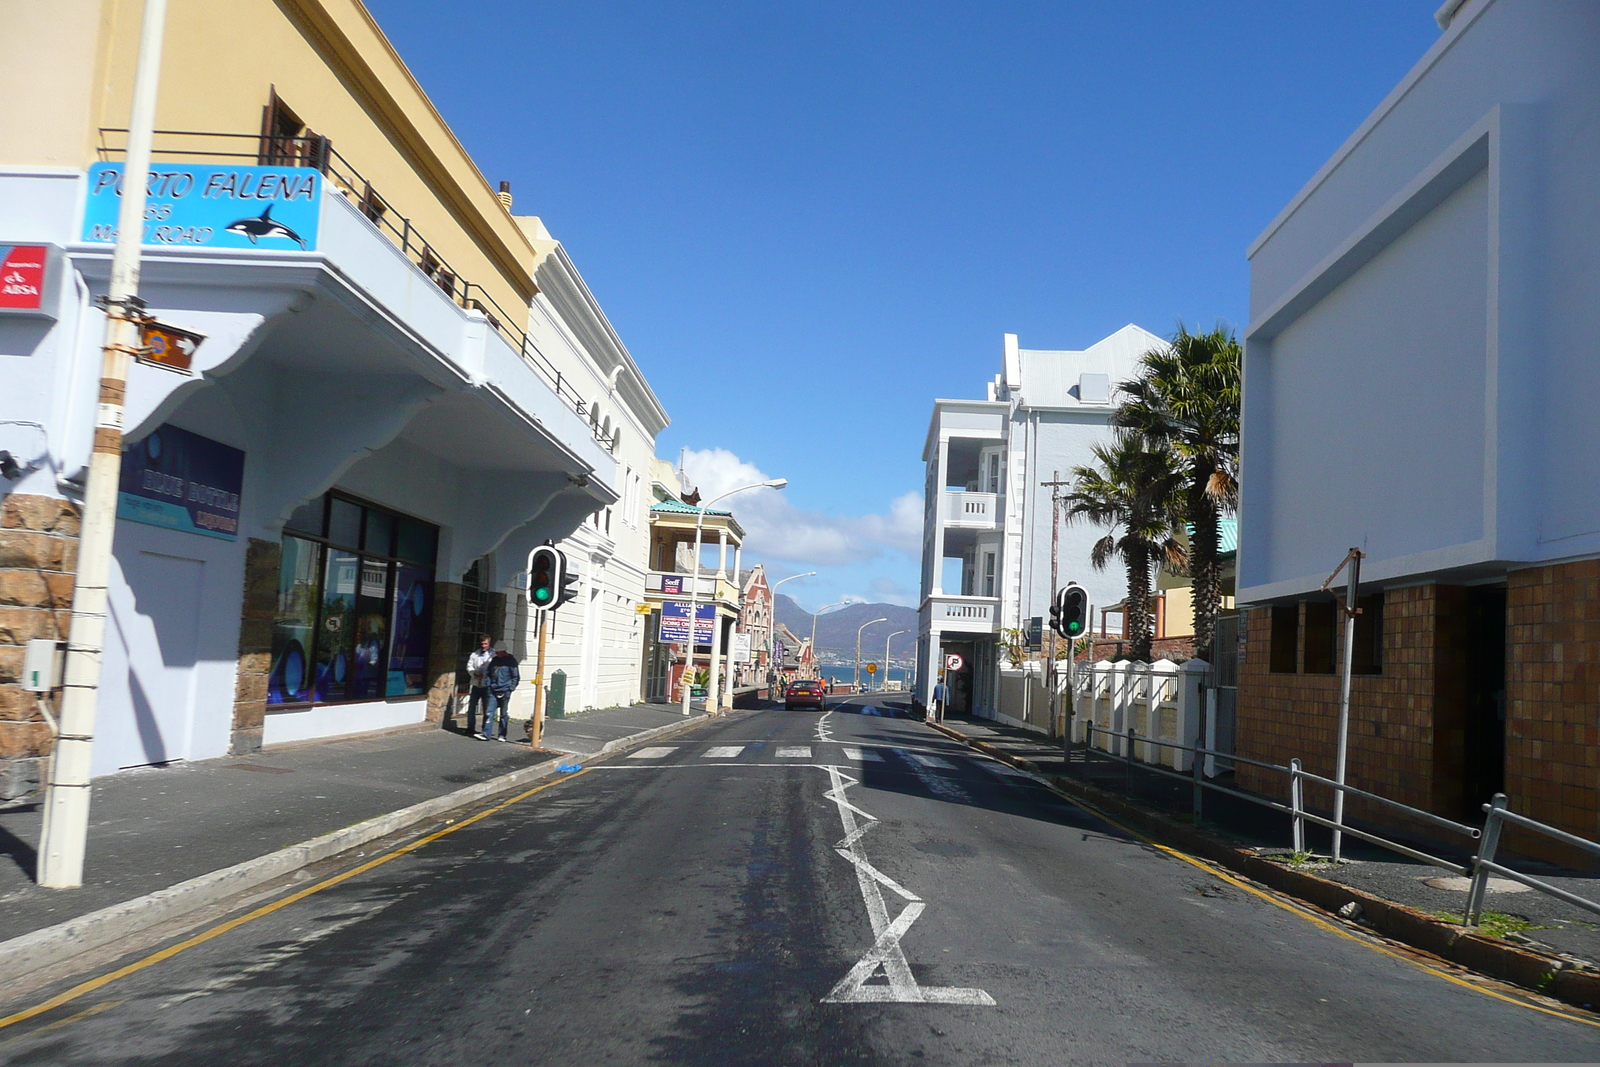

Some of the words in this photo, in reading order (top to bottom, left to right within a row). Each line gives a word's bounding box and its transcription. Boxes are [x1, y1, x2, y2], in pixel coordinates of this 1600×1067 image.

[201, 172, 315, 201] FALENA
[151, 225, 213, 244] ROAD
[1, 284, 39, 295] ABSA
[143, 468, 184, 498] BLUE
[188, 481, 239, 512] BOTTLE
